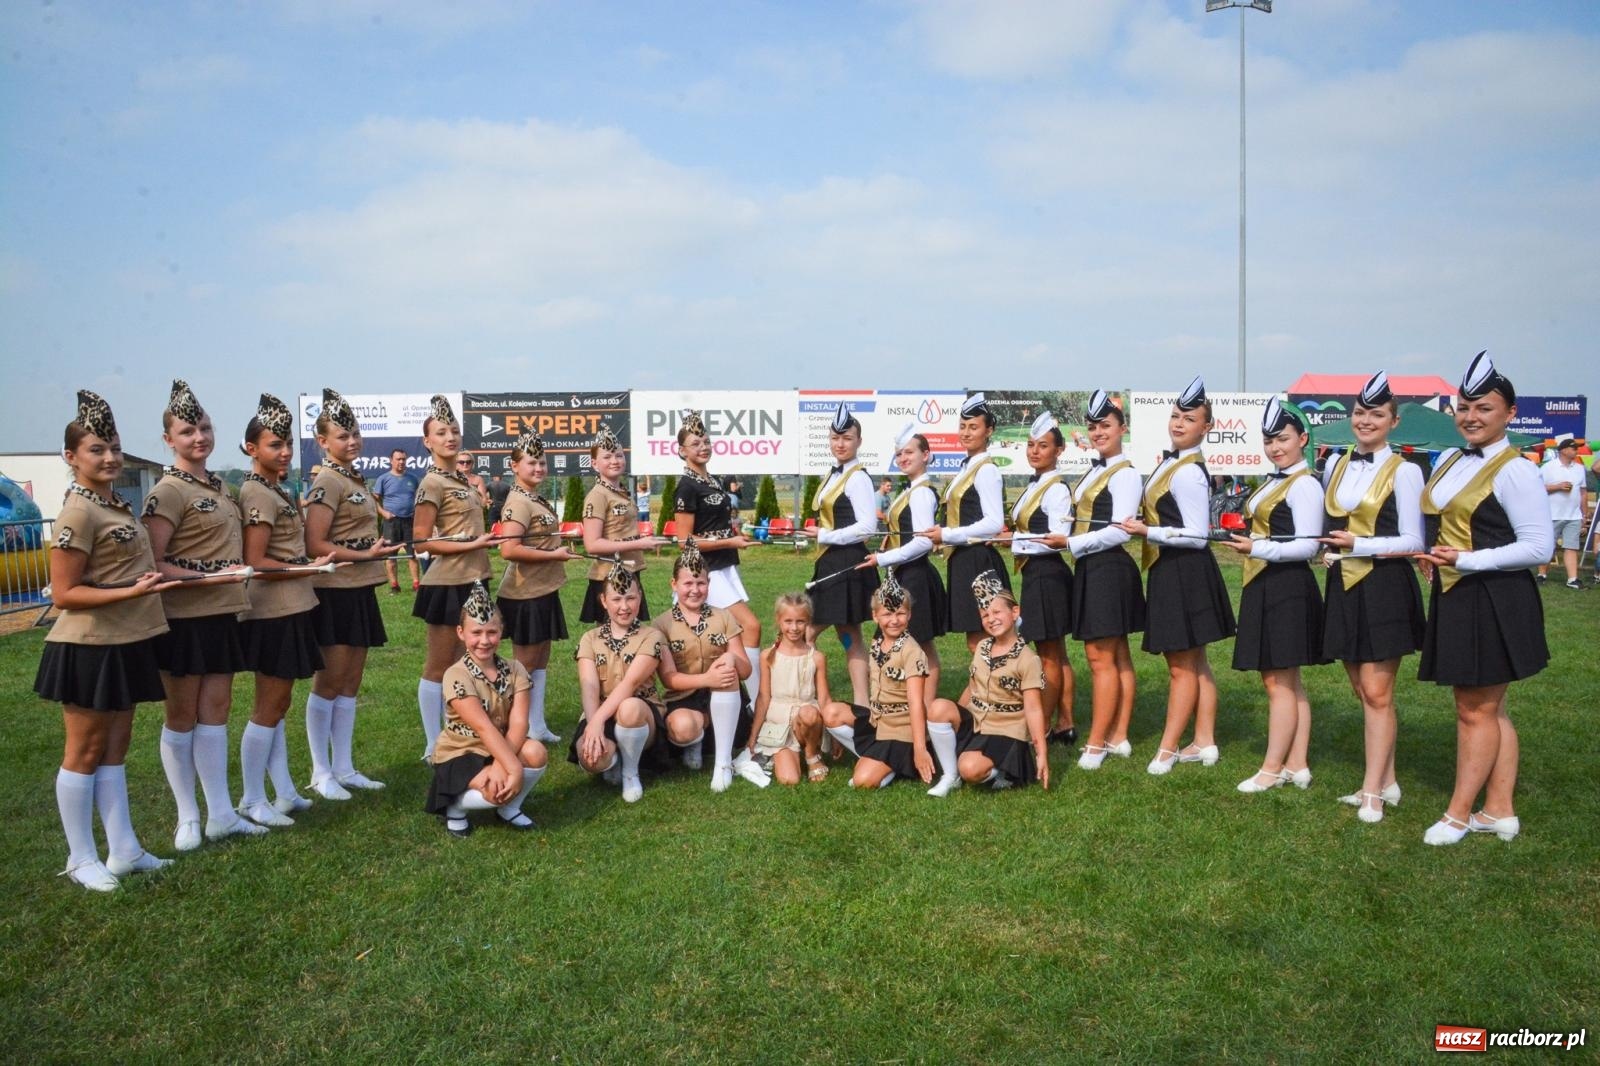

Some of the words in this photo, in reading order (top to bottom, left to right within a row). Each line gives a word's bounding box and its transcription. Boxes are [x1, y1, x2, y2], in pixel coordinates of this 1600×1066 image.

[470, 400, 499, 408] Racibórz,
[508, 400, 537, 408] Kolejowa
[1134, 397, 1164, 405] PRACA
[1232, 398, 1269, 406] NIEMCZ
[1545, 401, 1580, 410] Unilink
[350, 402, 388, 418] ruch
[804, 403, 856, 411] INSTALAJE
[887, 407, 916, 415] INSTAL
[942, 407, 958, 415] MIX
[505, 414, 601, 435] EXPERT
[1212, 418, 1247, 430] IMA
[1521, 416, 1543, 424] Ciebie
[1206, 431, 1247, 444] ORK
[480, 441, 507, 449] DRZWI
[555, 440, 580, 448] OKNA
[647, 440, 782, 455] TECOLOGY
[351, 456, 391, 470] STAR
[1208, 454, 1233, 465] 408
[1237, 454, 1261, 465] 858
